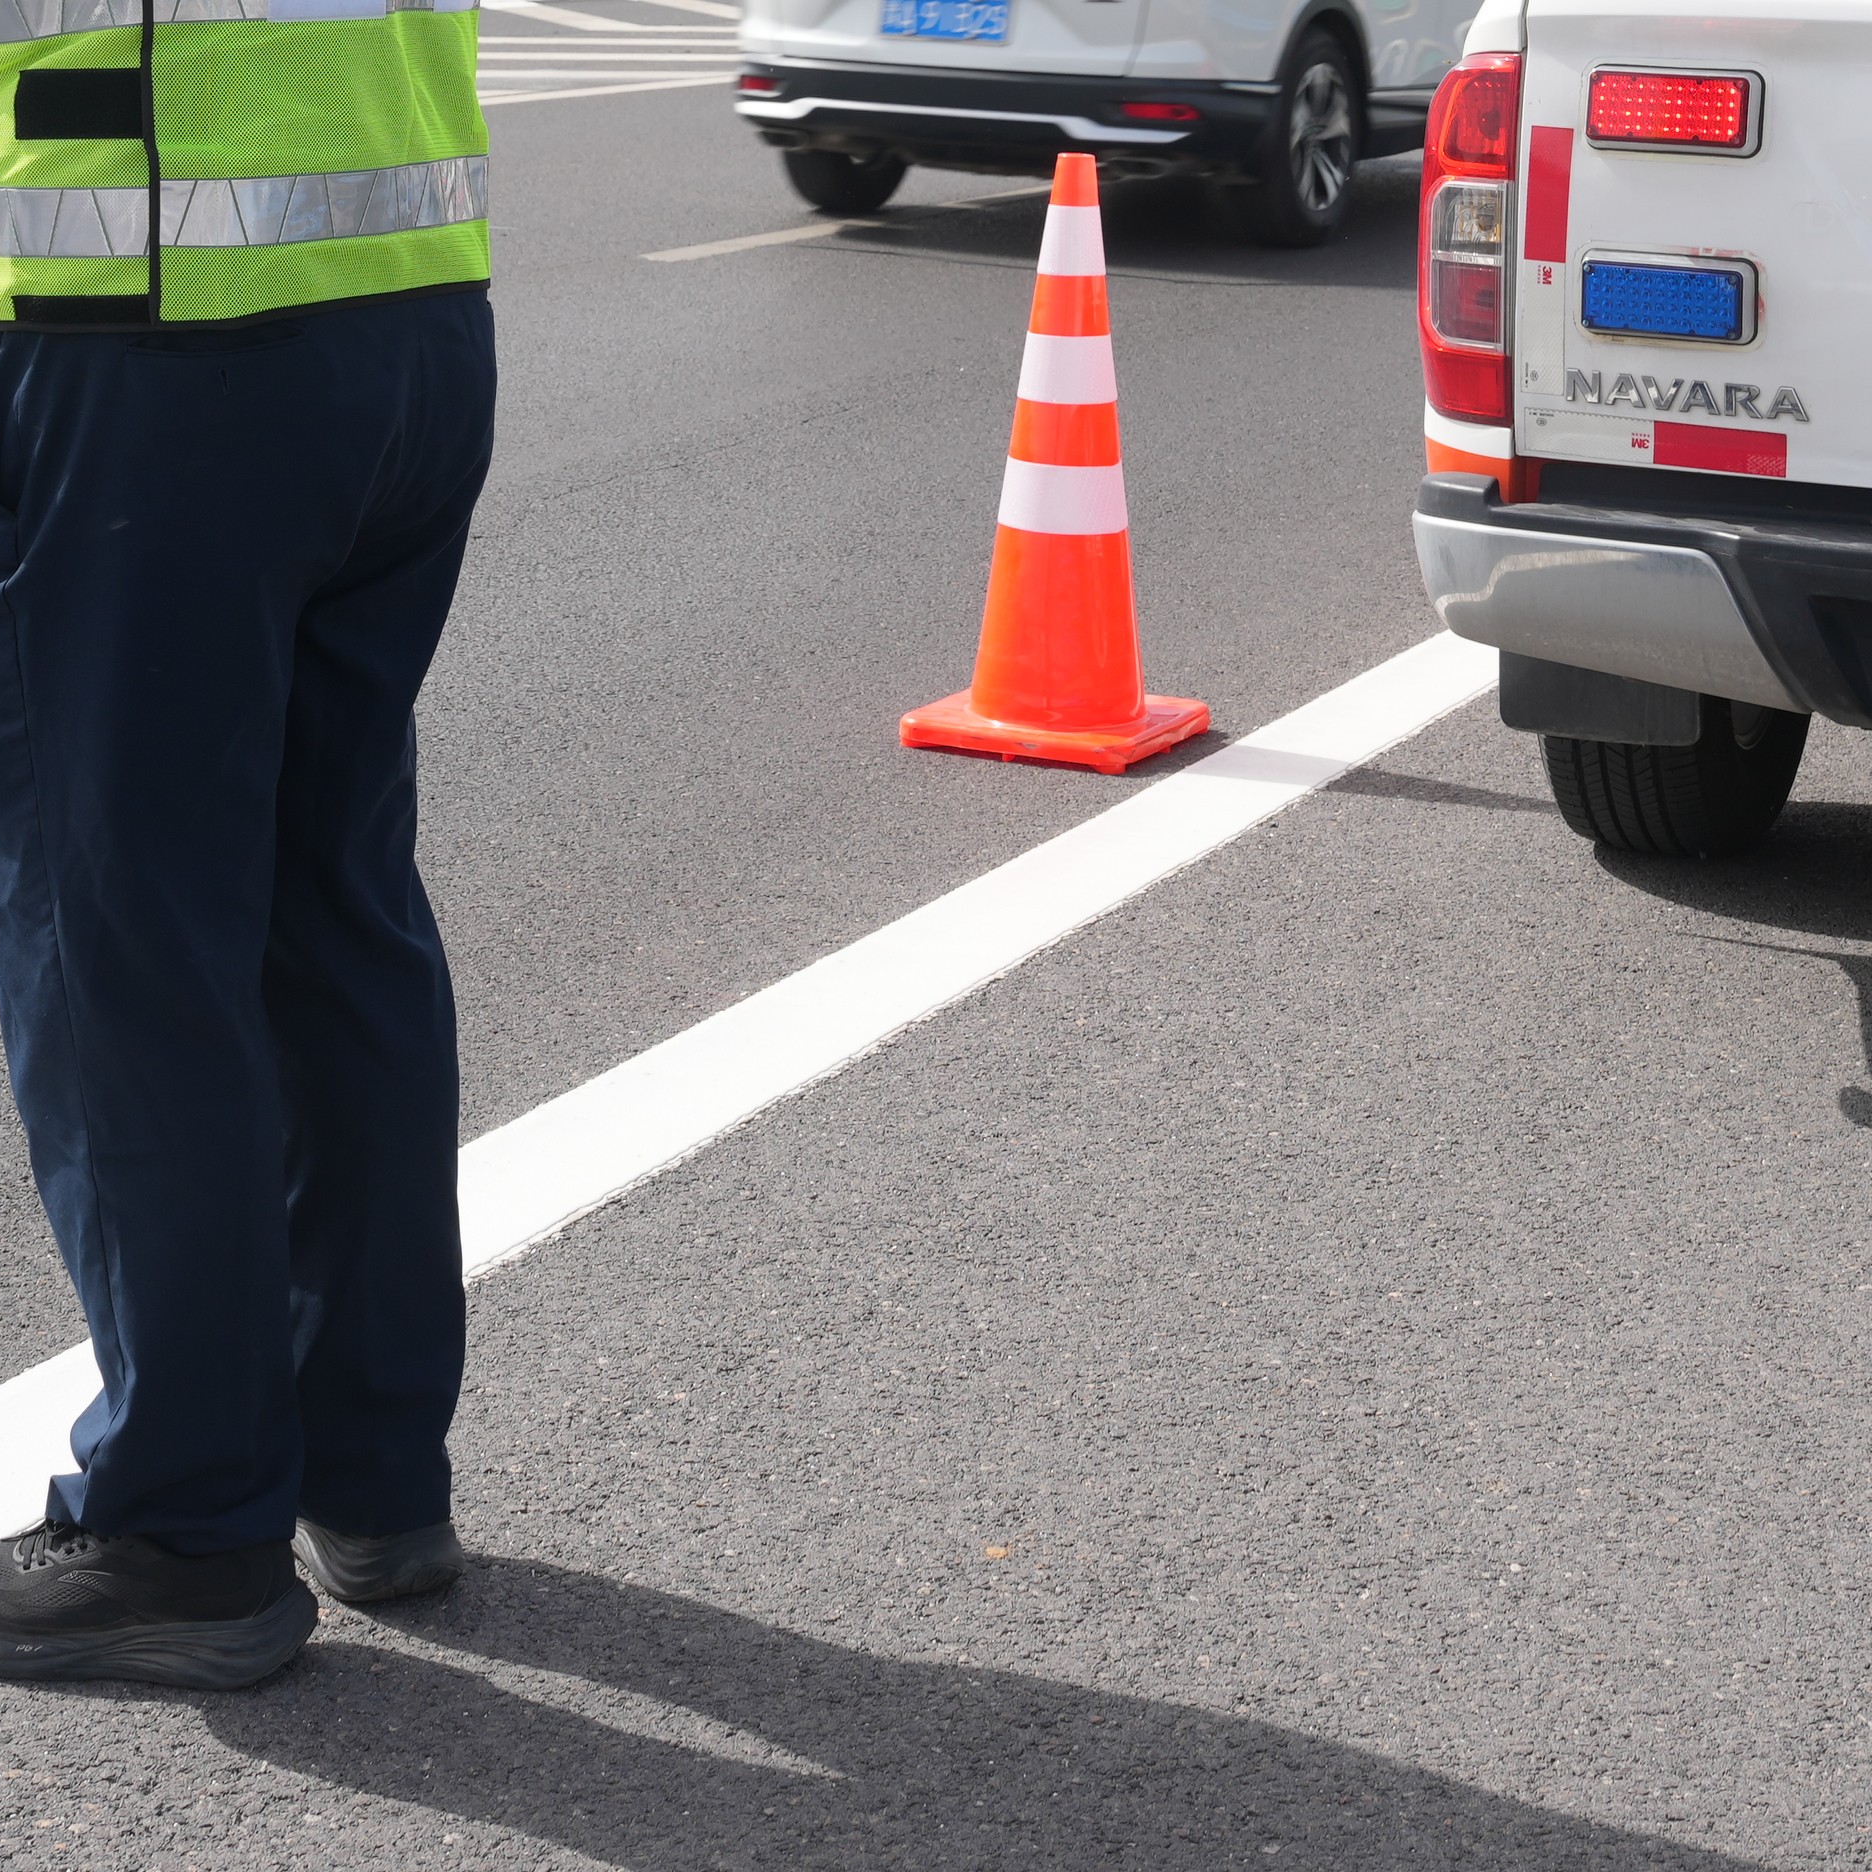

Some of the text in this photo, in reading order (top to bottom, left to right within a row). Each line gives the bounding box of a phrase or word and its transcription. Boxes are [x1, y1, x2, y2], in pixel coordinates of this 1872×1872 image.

[1542, 265, 1552, 285] 3M
[1565, 368, 1809, 423] NAVARA
[1631, 438, 1649, 449] 3M
